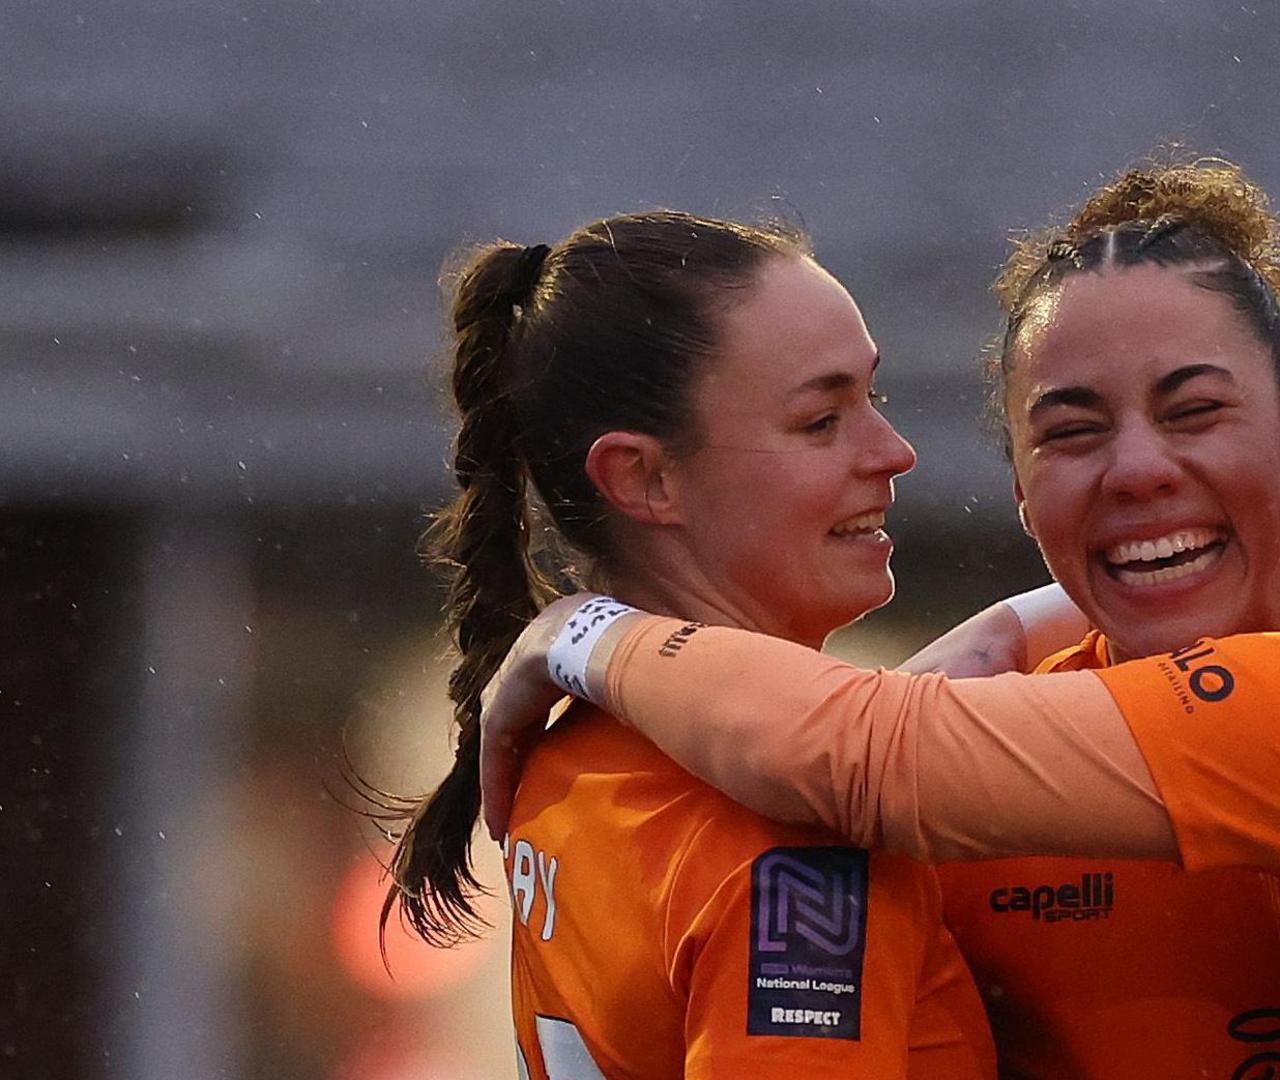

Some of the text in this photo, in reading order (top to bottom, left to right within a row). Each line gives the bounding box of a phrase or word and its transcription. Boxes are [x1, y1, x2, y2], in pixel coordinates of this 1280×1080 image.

[503, 832, 560, 941] AY
[989, 871, 1115, 920] capelli
[757, 977, 856, 995] National League
[771, 1007, 841, 1026] RESPECT
